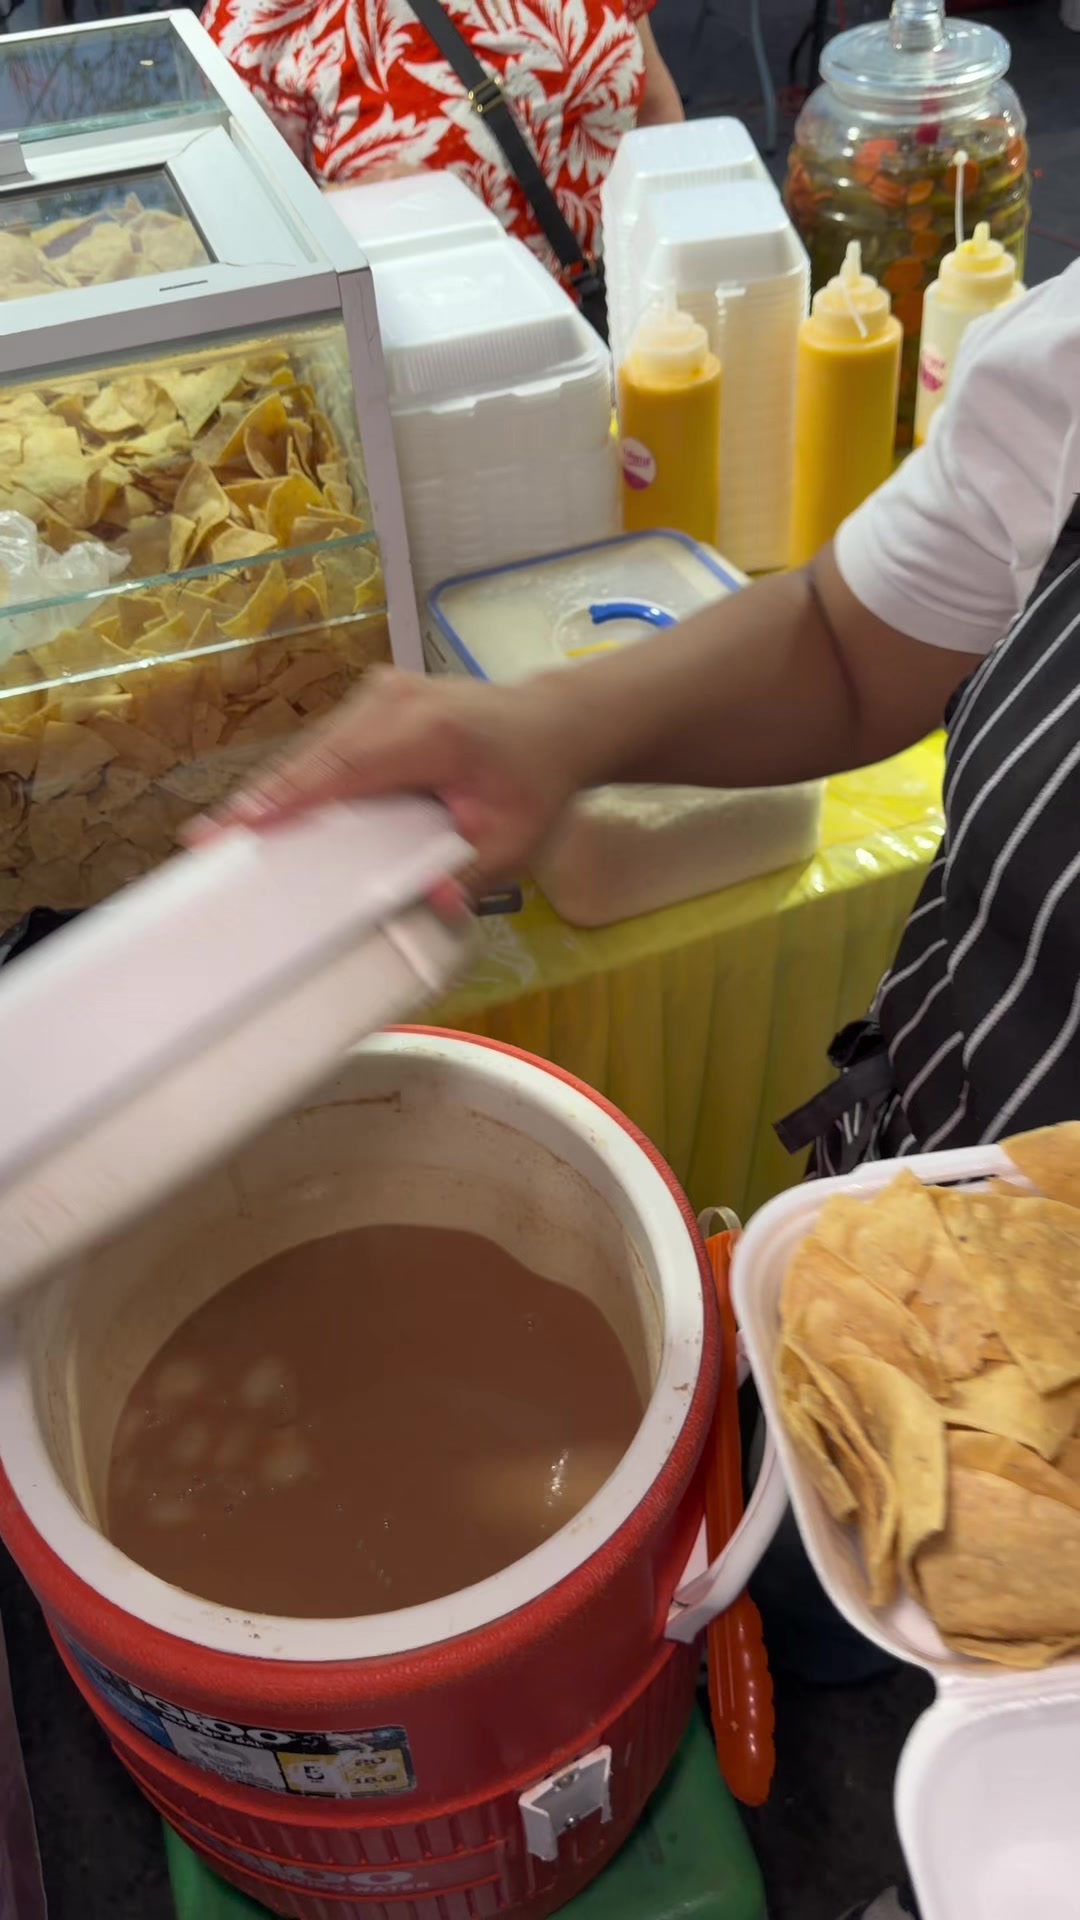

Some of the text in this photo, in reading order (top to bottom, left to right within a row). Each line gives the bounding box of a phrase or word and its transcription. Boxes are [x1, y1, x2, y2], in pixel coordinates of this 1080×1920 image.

[128, 1684, 292, 1744] IGLOO
[303, 1764, 325, 1781] 5
[351, 1881, 430, 1893] WATER
